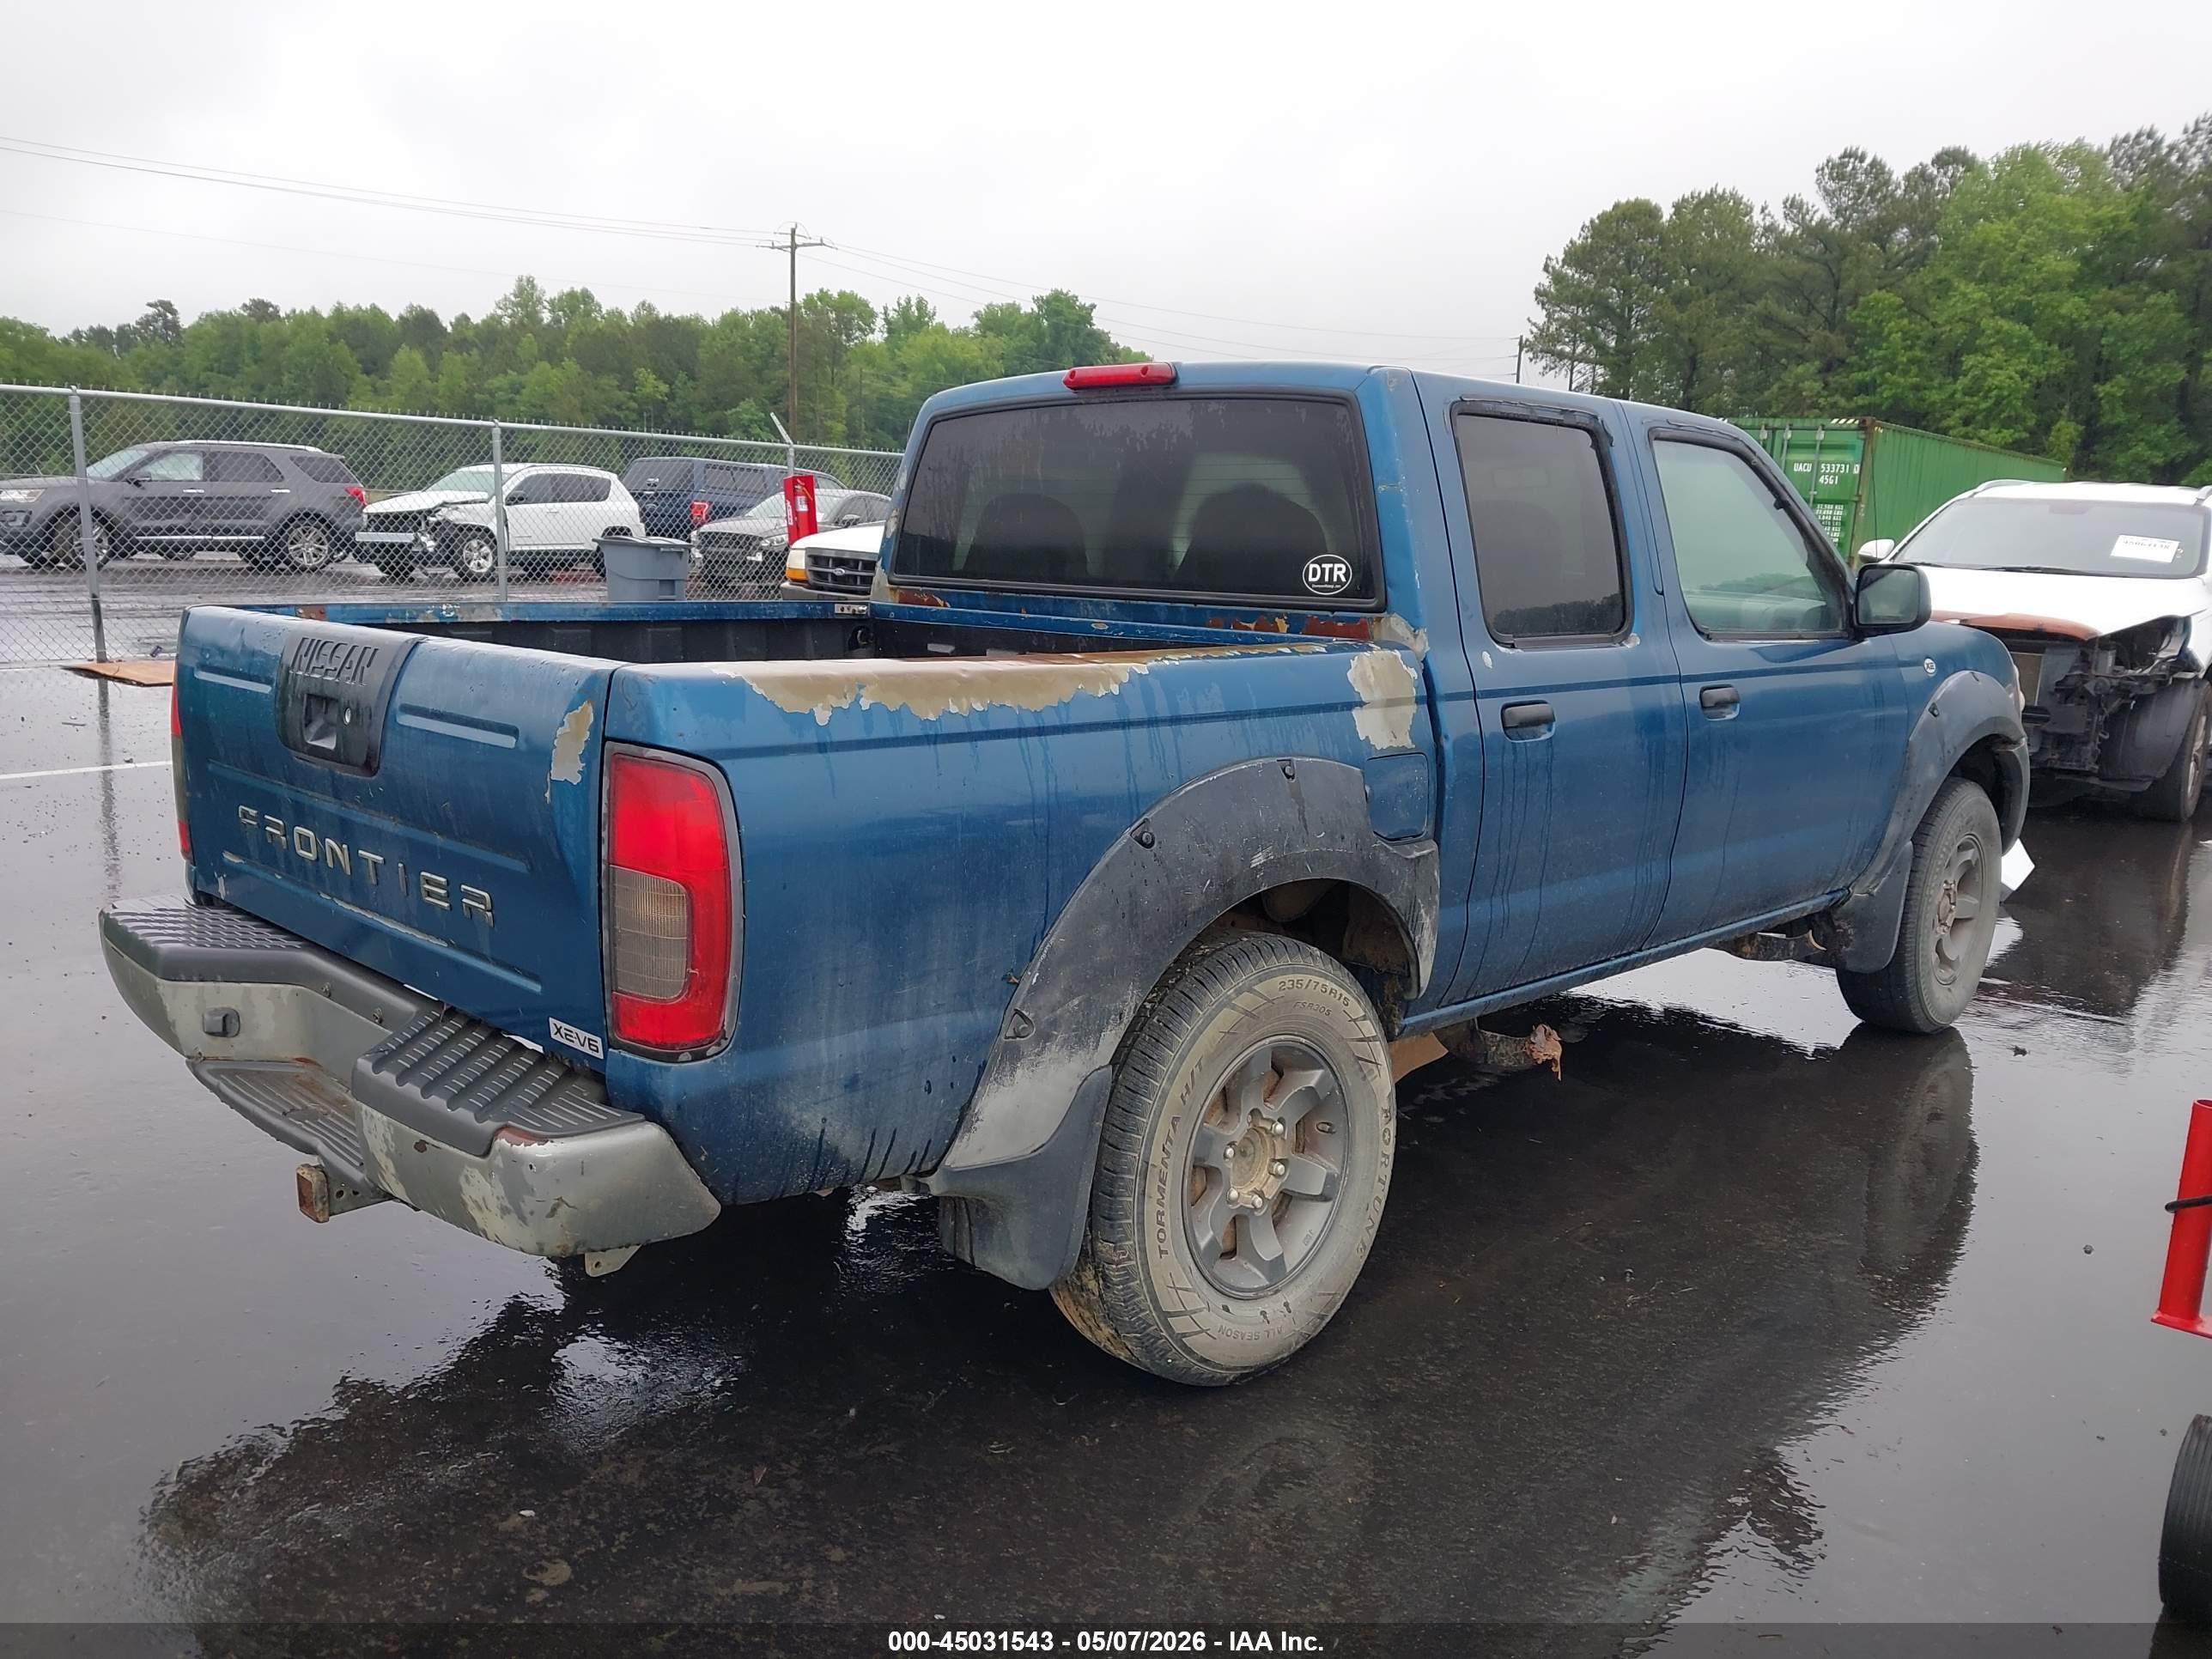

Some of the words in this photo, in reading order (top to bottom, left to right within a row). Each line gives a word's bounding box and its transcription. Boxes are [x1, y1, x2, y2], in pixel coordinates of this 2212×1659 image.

[1793, 463, 1812, 471] UACU
[1820, 464, 1850, 473] 533731
[1819, 475, 1838, 484] 45G1
[1308, 563, 1346, 582] DTR
[289, 636, 380, 686] NISSAN
[239, 805, 495, 927] FRONTIER
[1279, 979, 1351, 1007] 235/75R15
[1292, 1001, 1332, 1017] FSR305
[1156, 1115, 1182, 1259] TORMENTA
[1179, 1055, 1203, 1106] H/T
[1356, 1106, 1393, 1261] FORTUNE
[1218, 1325, 1261, 1340] SEASON
[1264, 1325, 1284, 1339] ALL
